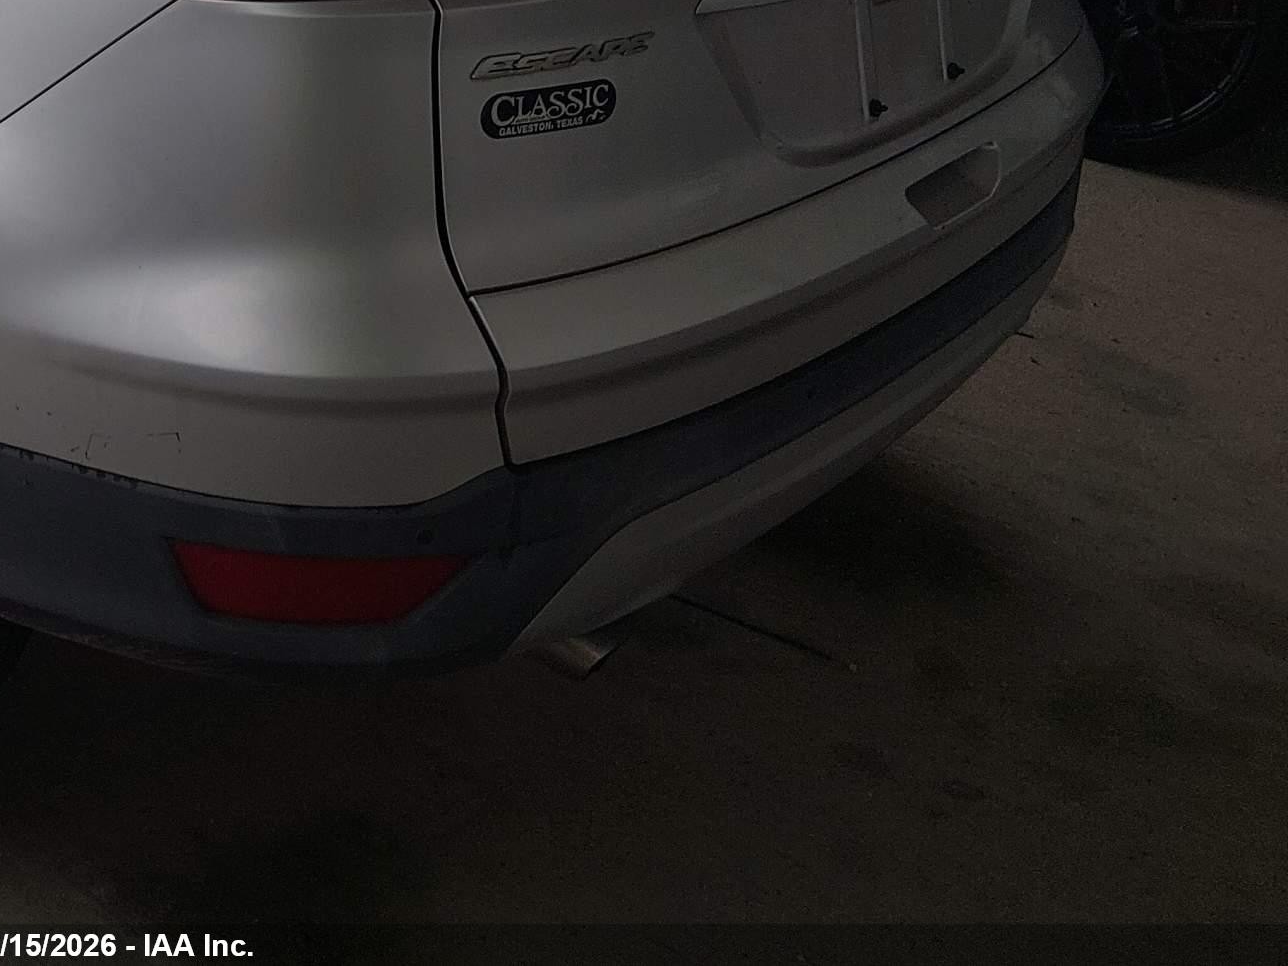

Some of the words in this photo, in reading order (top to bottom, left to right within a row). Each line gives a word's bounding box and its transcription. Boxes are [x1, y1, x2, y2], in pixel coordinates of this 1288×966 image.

[470, 30, 655, 81] ESCAPE
[490, 83, 610, 128] CLASSIC
[557, 115, 584, 130] TEXAS
